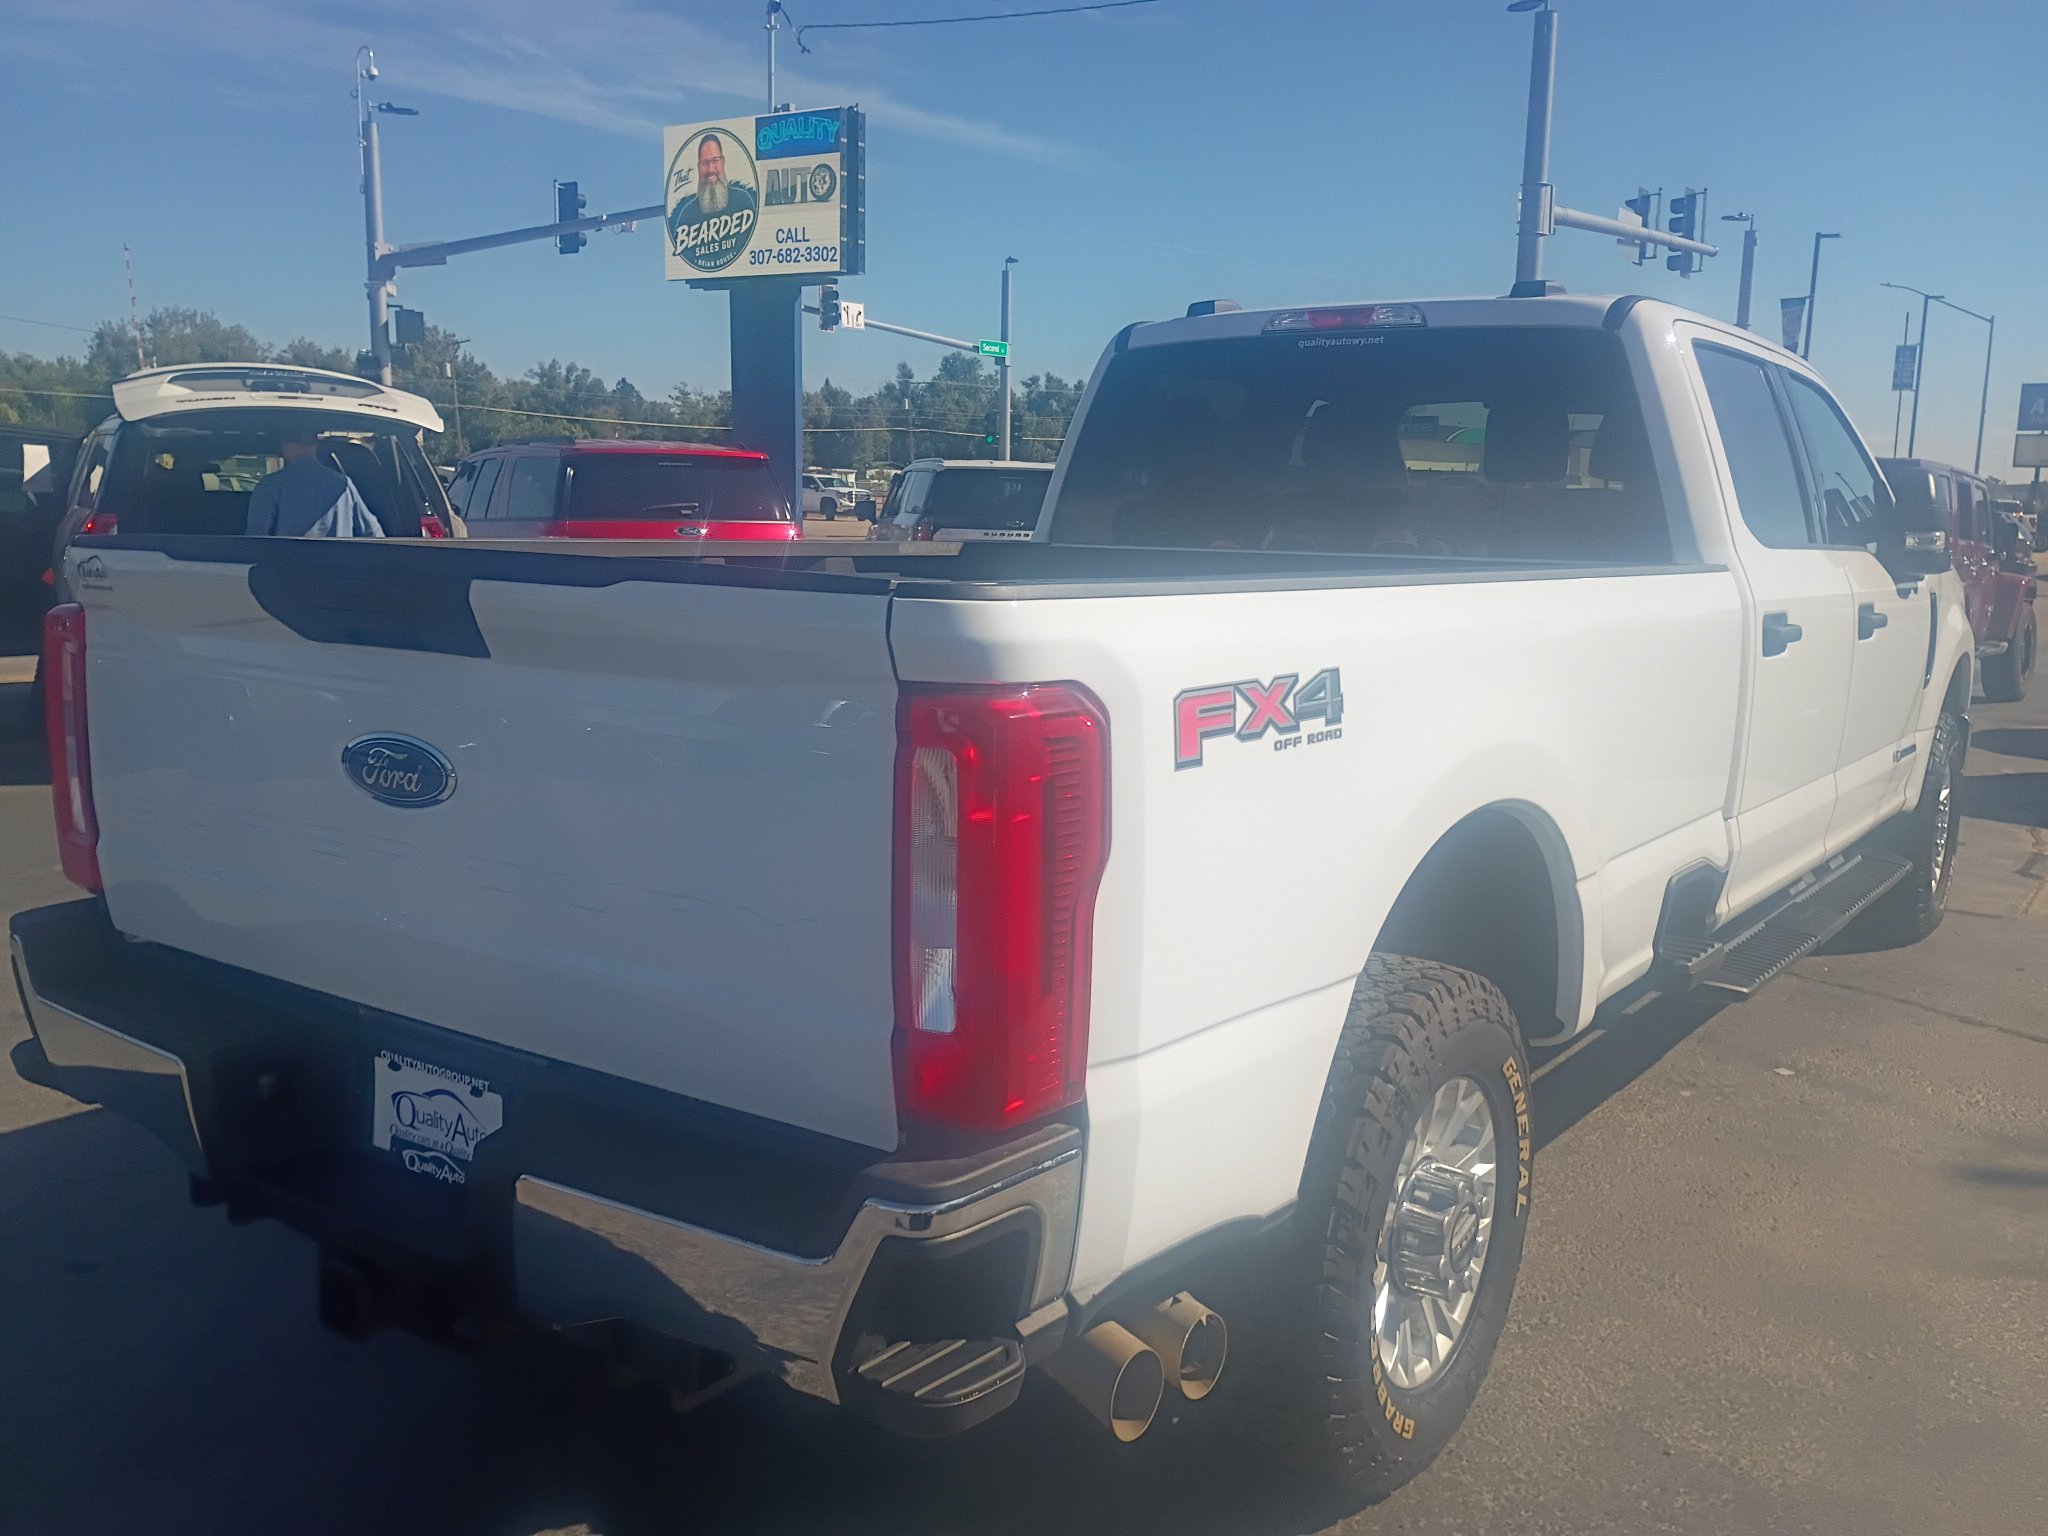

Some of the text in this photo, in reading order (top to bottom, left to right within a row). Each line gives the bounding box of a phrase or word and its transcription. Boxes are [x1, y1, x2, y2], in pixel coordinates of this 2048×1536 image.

[757, 116, 840, 150] QUALITY
[673, 167, 694, 187] That
[674, 209, 754, 255] BEARDED
[776, 227, 810, 244] CALL
[695, 238, 737, 257] SALES GUY
[749, 246, 839, 266] 307-682-3302
[982, 343, 1000, 353] Second
[1298, 336, 1385, 350] qualityautowy.net
[1173, 666, 1344, 772] FX4
[1273, 728, 1343, 752] OFF ROAD
[362, 746, 423, 793] Ford
[1502, 1056, 1530, 1217] GENERAL
